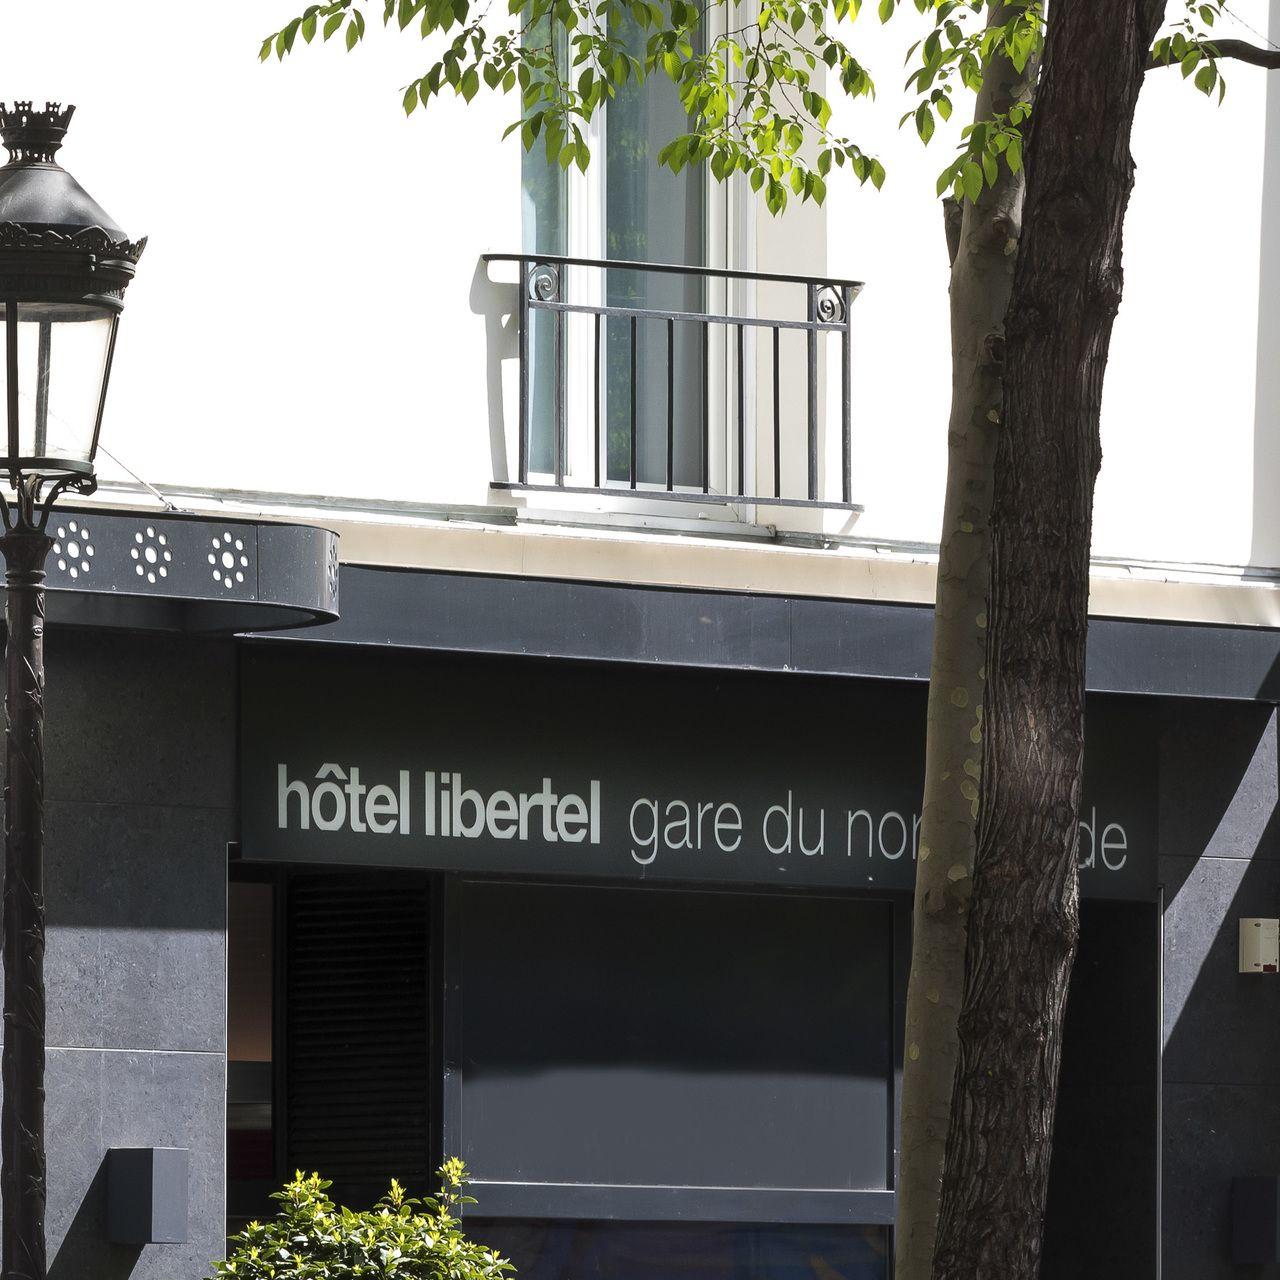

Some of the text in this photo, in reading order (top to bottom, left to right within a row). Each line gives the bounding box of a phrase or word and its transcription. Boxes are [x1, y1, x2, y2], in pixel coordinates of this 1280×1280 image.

[277, 762, 923, 866] hôtel libertel gare du nor
